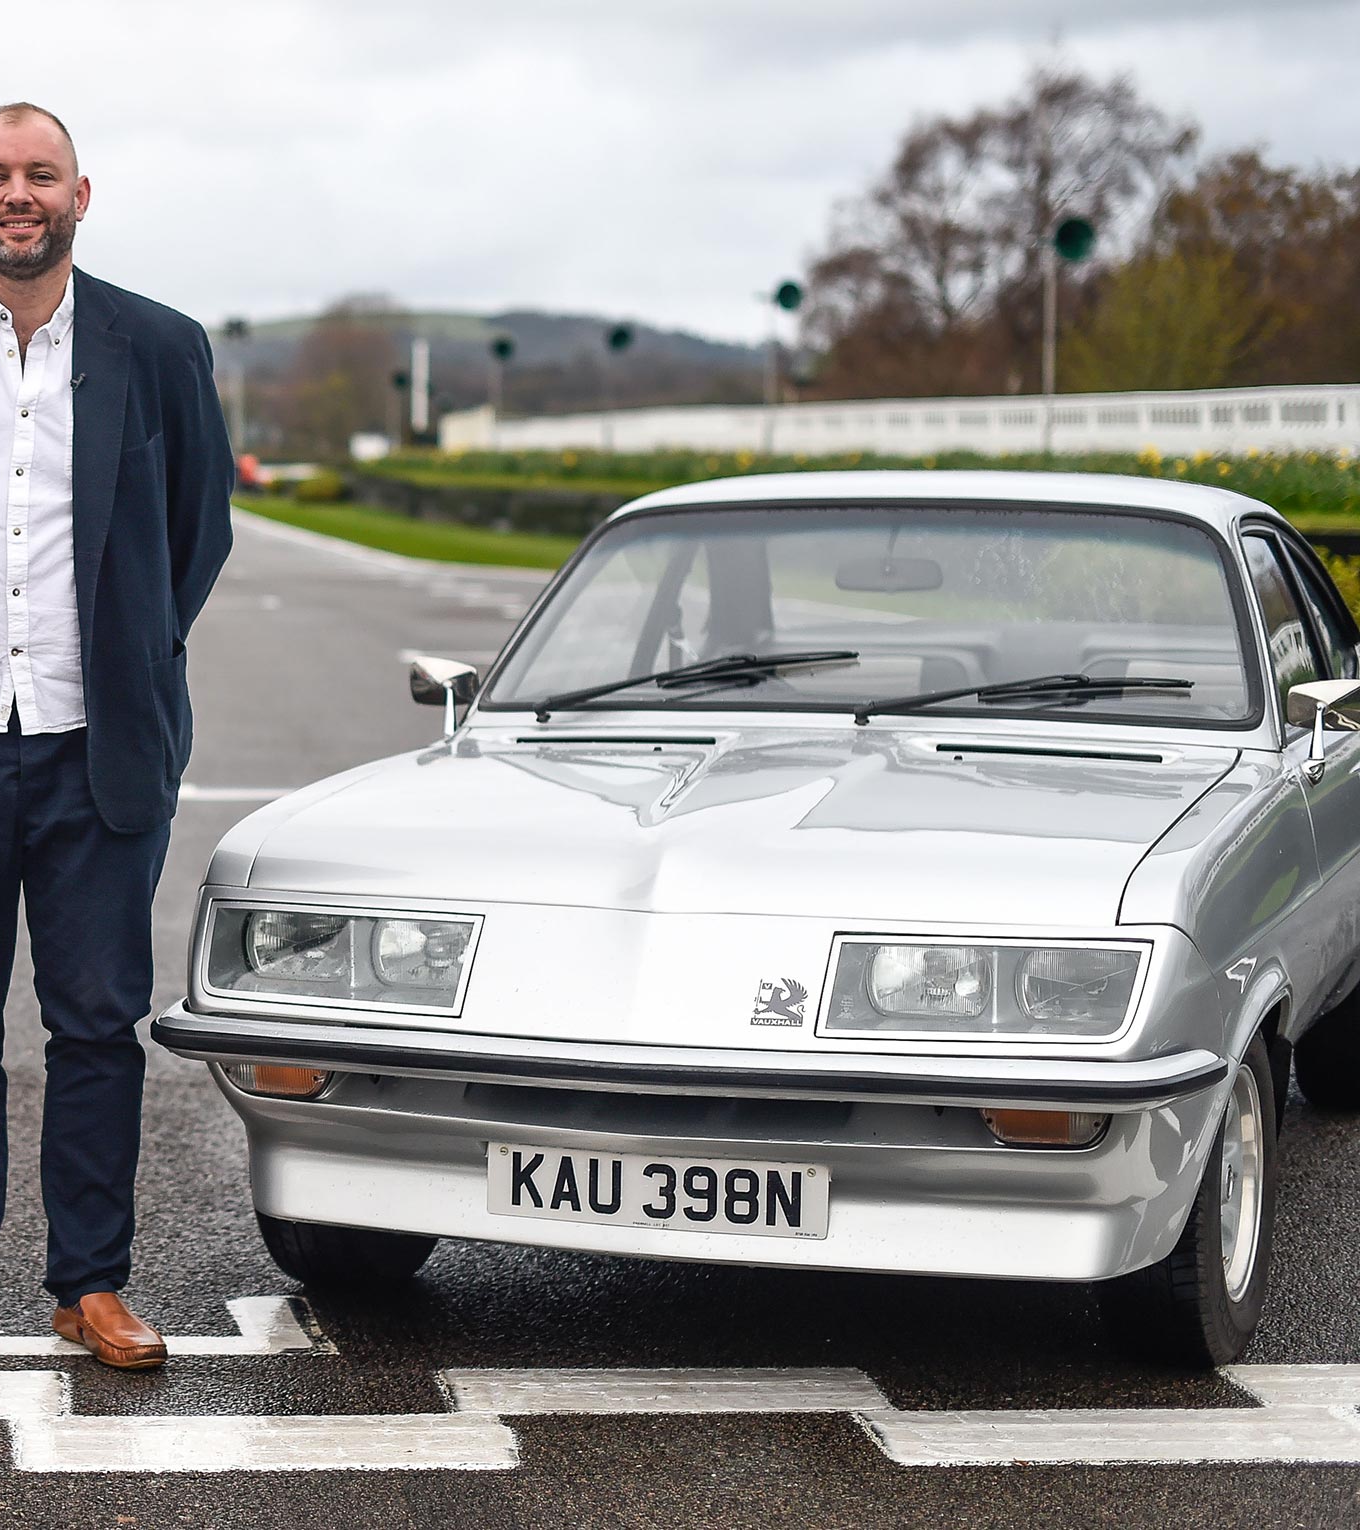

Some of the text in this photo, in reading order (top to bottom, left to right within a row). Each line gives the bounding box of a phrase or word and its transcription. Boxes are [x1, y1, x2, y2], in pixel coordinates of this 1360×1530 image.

[751, 1018, 802, 1027] VAUXHALL
[511, 1150, 803, 1228] KAU 398N
